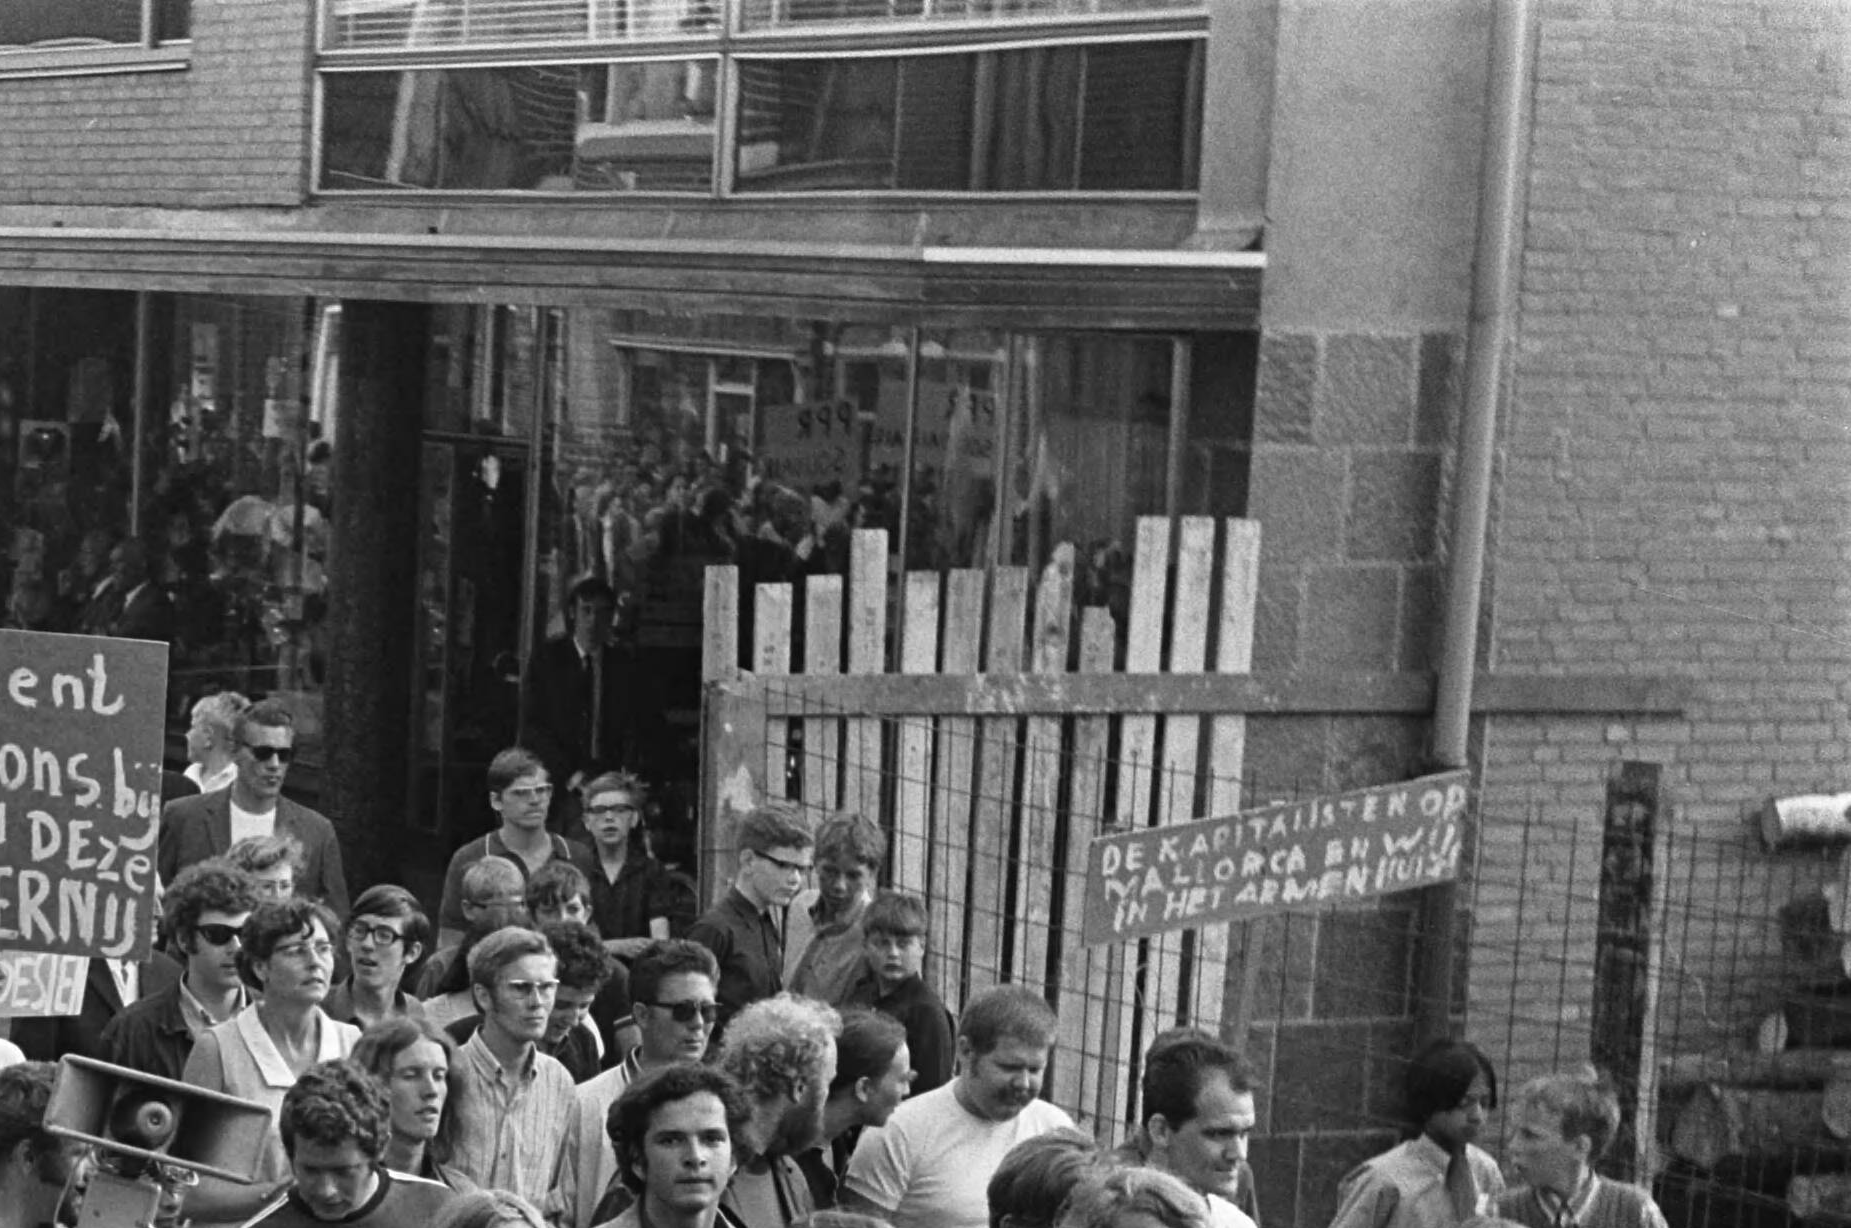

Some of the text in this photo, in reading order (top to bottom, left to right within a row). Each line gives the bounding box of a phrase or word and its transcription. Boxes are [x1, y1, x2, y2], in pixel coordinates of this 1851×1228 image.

[1102, 842, 1146, 877] DE
[1420, 783, 1467, 821] OP
[1113, 899, 1148, 933] IN
[1163, 885, 1226, 921] HET
